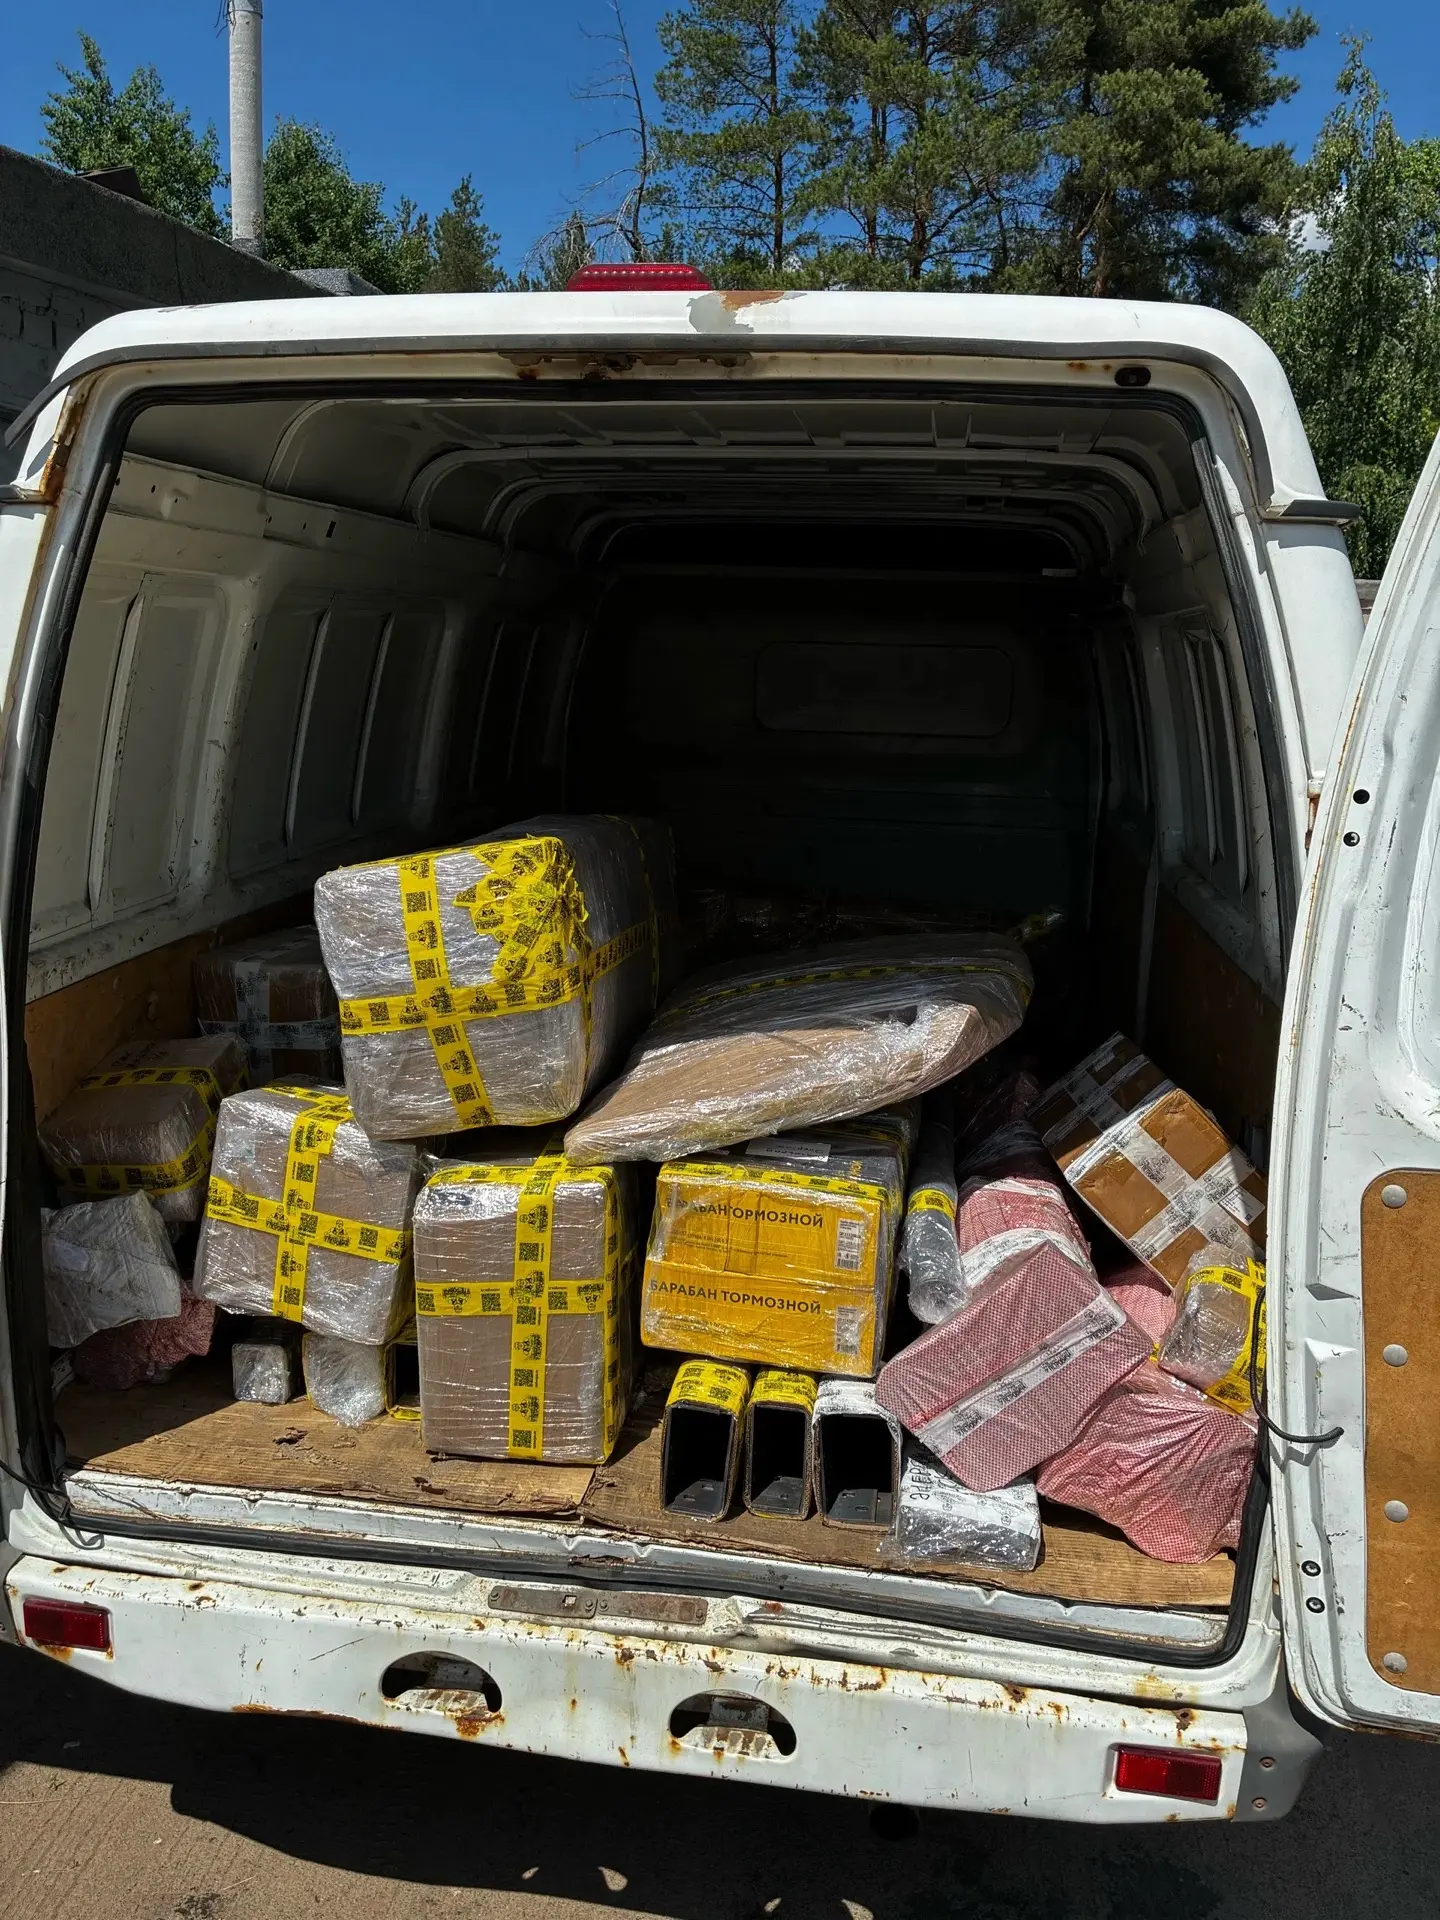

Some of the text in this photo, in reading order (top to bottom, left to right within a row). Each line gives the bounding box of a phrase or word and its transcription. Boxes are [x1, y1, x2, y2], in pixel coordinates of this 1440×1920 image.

[728, 1206, 823, 1228] ОРМОЗНОЙ
[650, 1280, 821, 1315] БАРАБАН ТОРМОЗНОЙ
